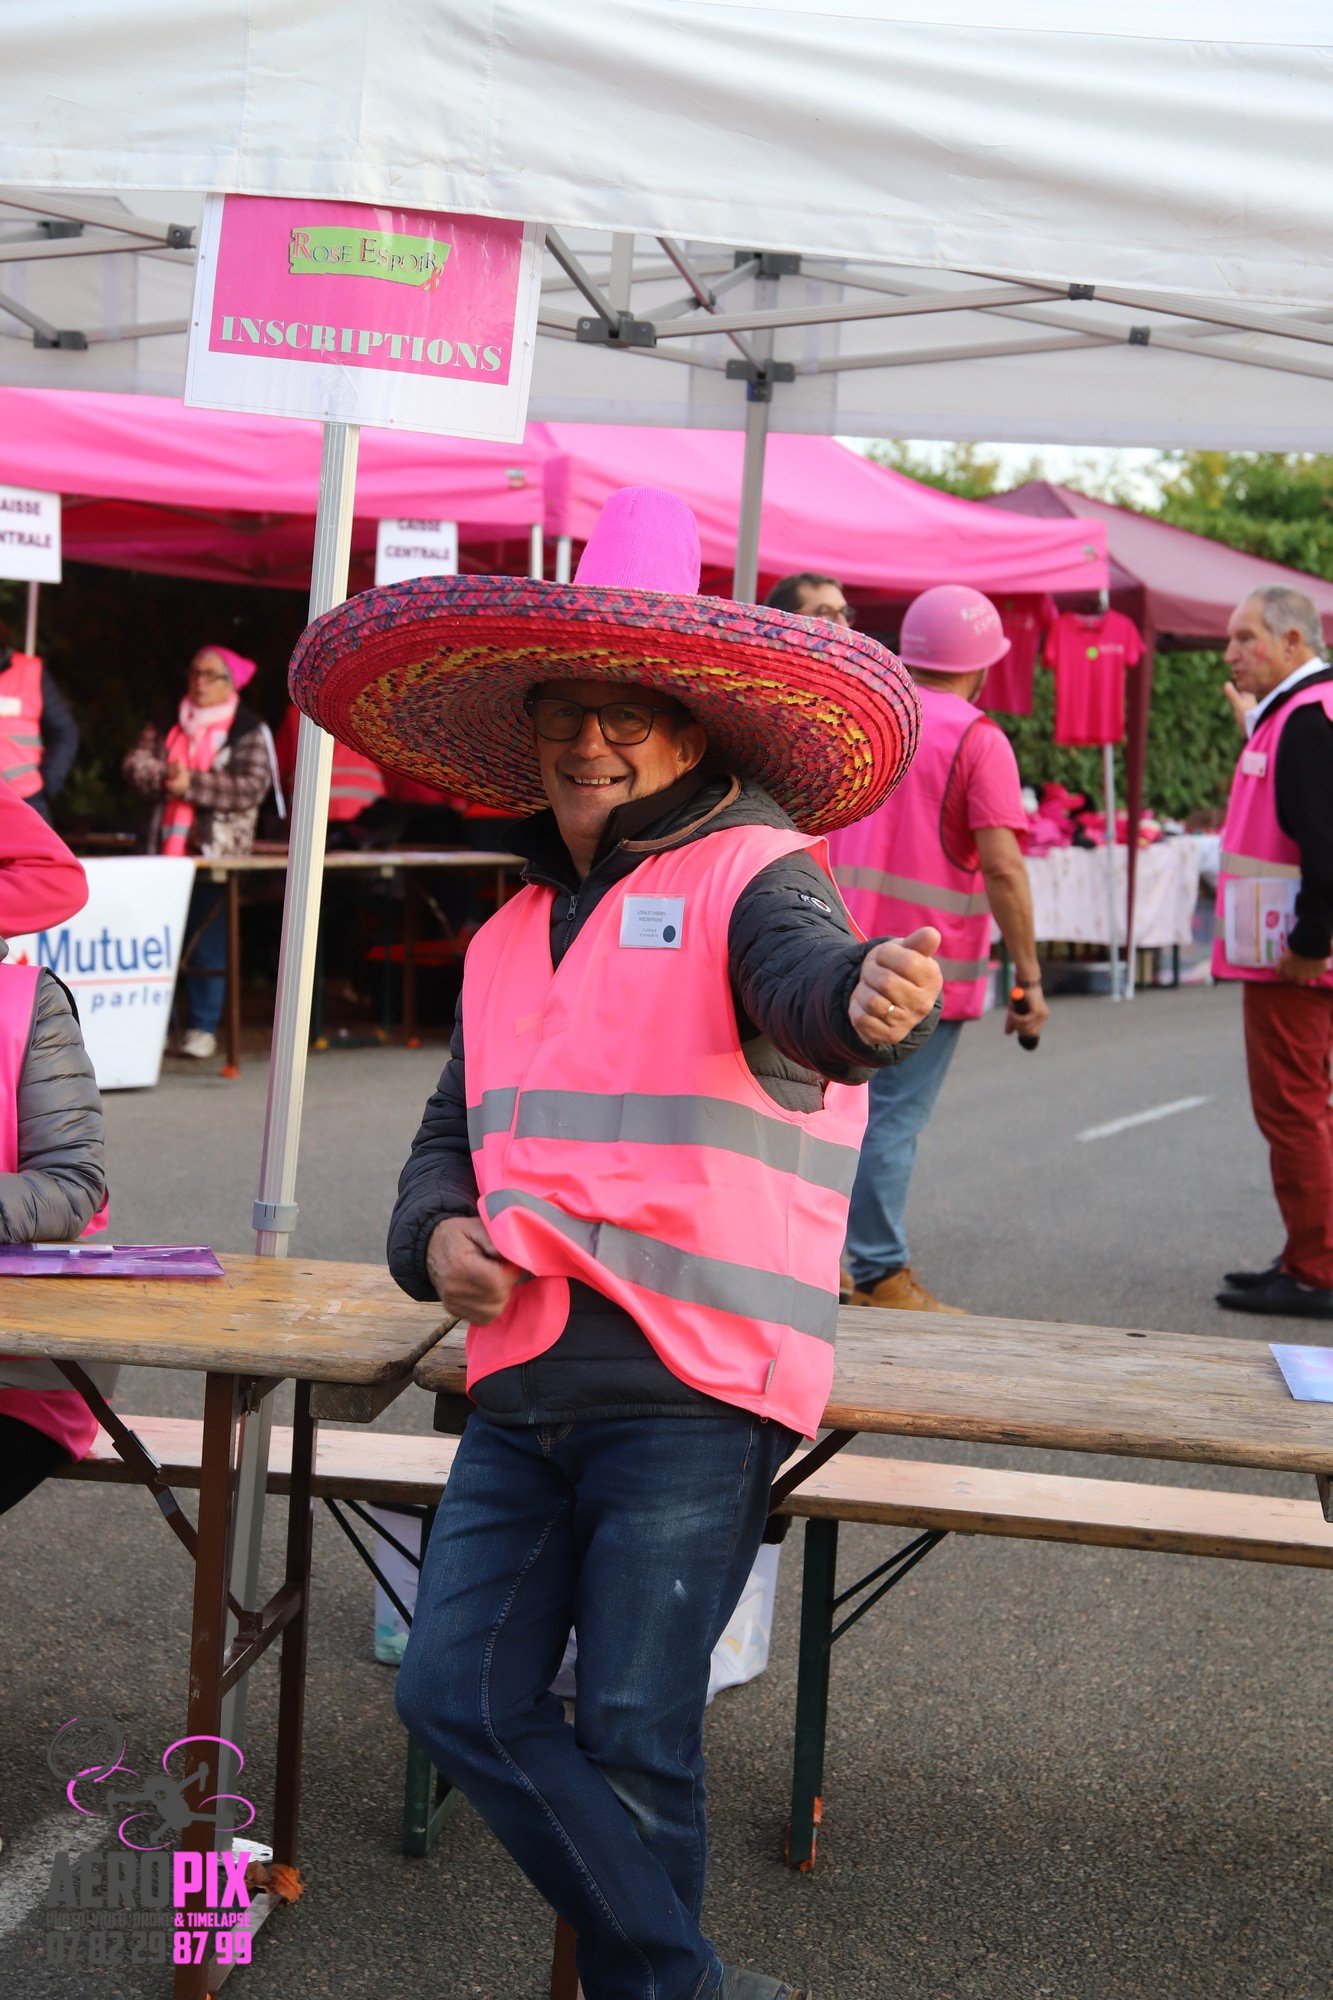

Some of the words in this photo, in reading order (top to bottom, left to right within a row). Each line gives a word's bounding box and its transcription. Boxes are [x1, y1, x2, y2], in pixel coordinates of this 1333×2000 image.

[219, 315, 503, 372] INSCRIPTIONS
[0, 498, 41, 516] AISSE
[0, 530, 51, 549] NTRALE
[385, 545, 449, 560] CENTRALE
[37, 925, 172, 973] Mutuel
